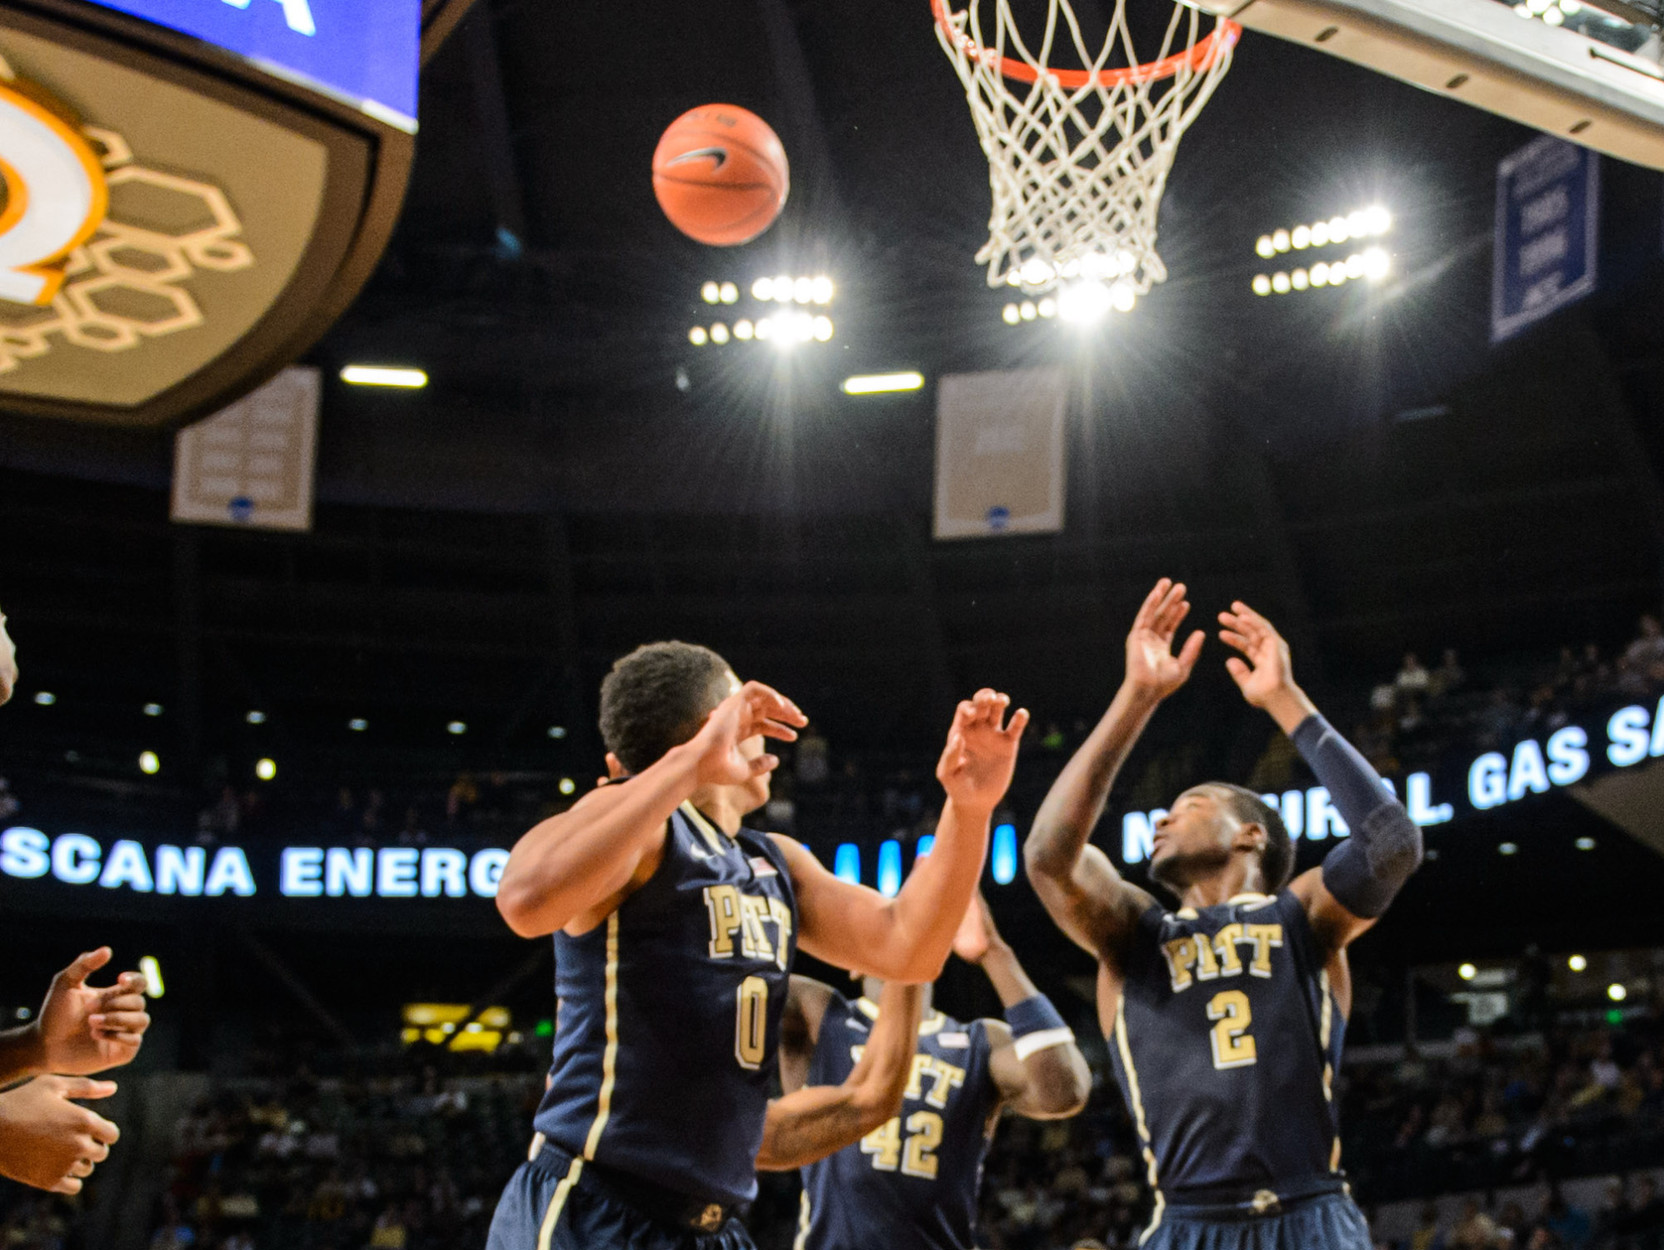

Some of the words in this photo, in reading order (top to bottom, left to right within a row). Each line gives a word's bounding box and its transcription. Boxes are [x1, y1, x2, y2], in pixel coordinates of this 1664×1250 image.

[1467, 726, 1590, 810] GAS
[0, 826, 256, 897] SCANA
[1162, 923, 1283, 993] PITT
[735, 975, 768, 1070] 0
[1206, 989, 1257, 1070] 2
[860, 1110, 943, 1180] 42
